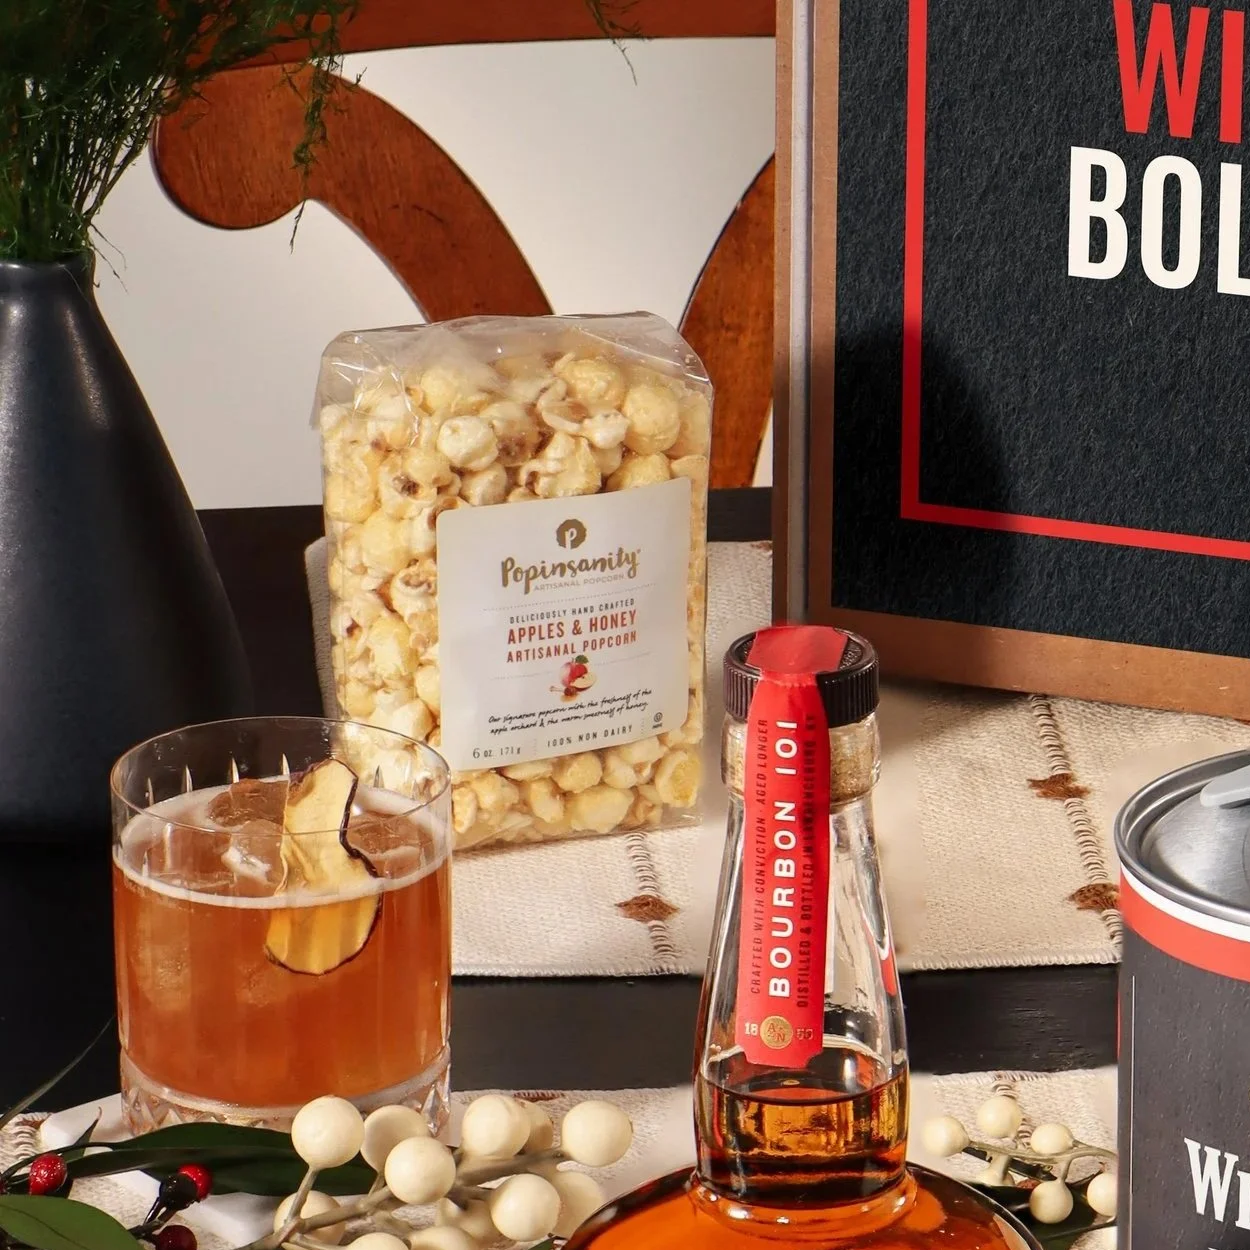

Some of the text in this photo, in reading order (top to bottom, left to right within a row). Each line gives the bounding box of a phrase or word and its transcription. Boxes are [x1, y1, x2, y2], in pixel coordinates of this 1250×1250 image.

[501, 547, 639, 595] Popinsanity
[534, 574, 624, 591] ARTISANAL POPCORN
[510, 598, 635, 624] DELICIOUSLY HAND CRAFTED
[508, 610, 636, 645] APPLES & HONEY
[507, 631, 636, 663] ARTISANAL POPCORN
[503, 713, 536, 724] signature
[538, 707, 567, 718] popcorn
[547, 725, 632, 748] 100% NON DAIRY
[473, 748, 480, 759] 6
[751, 719, 768, 994] CRAFTED WITH CONVICTION AGED LONGER
[768, 721, 798, 998] BOURBON 101
[801, 862, 814, 920] BOTTLED
[800, 926, 812, 936] &
[796, 941, 812, 1008] DISTILLED
[744, 1022, 759, 1036] 18
